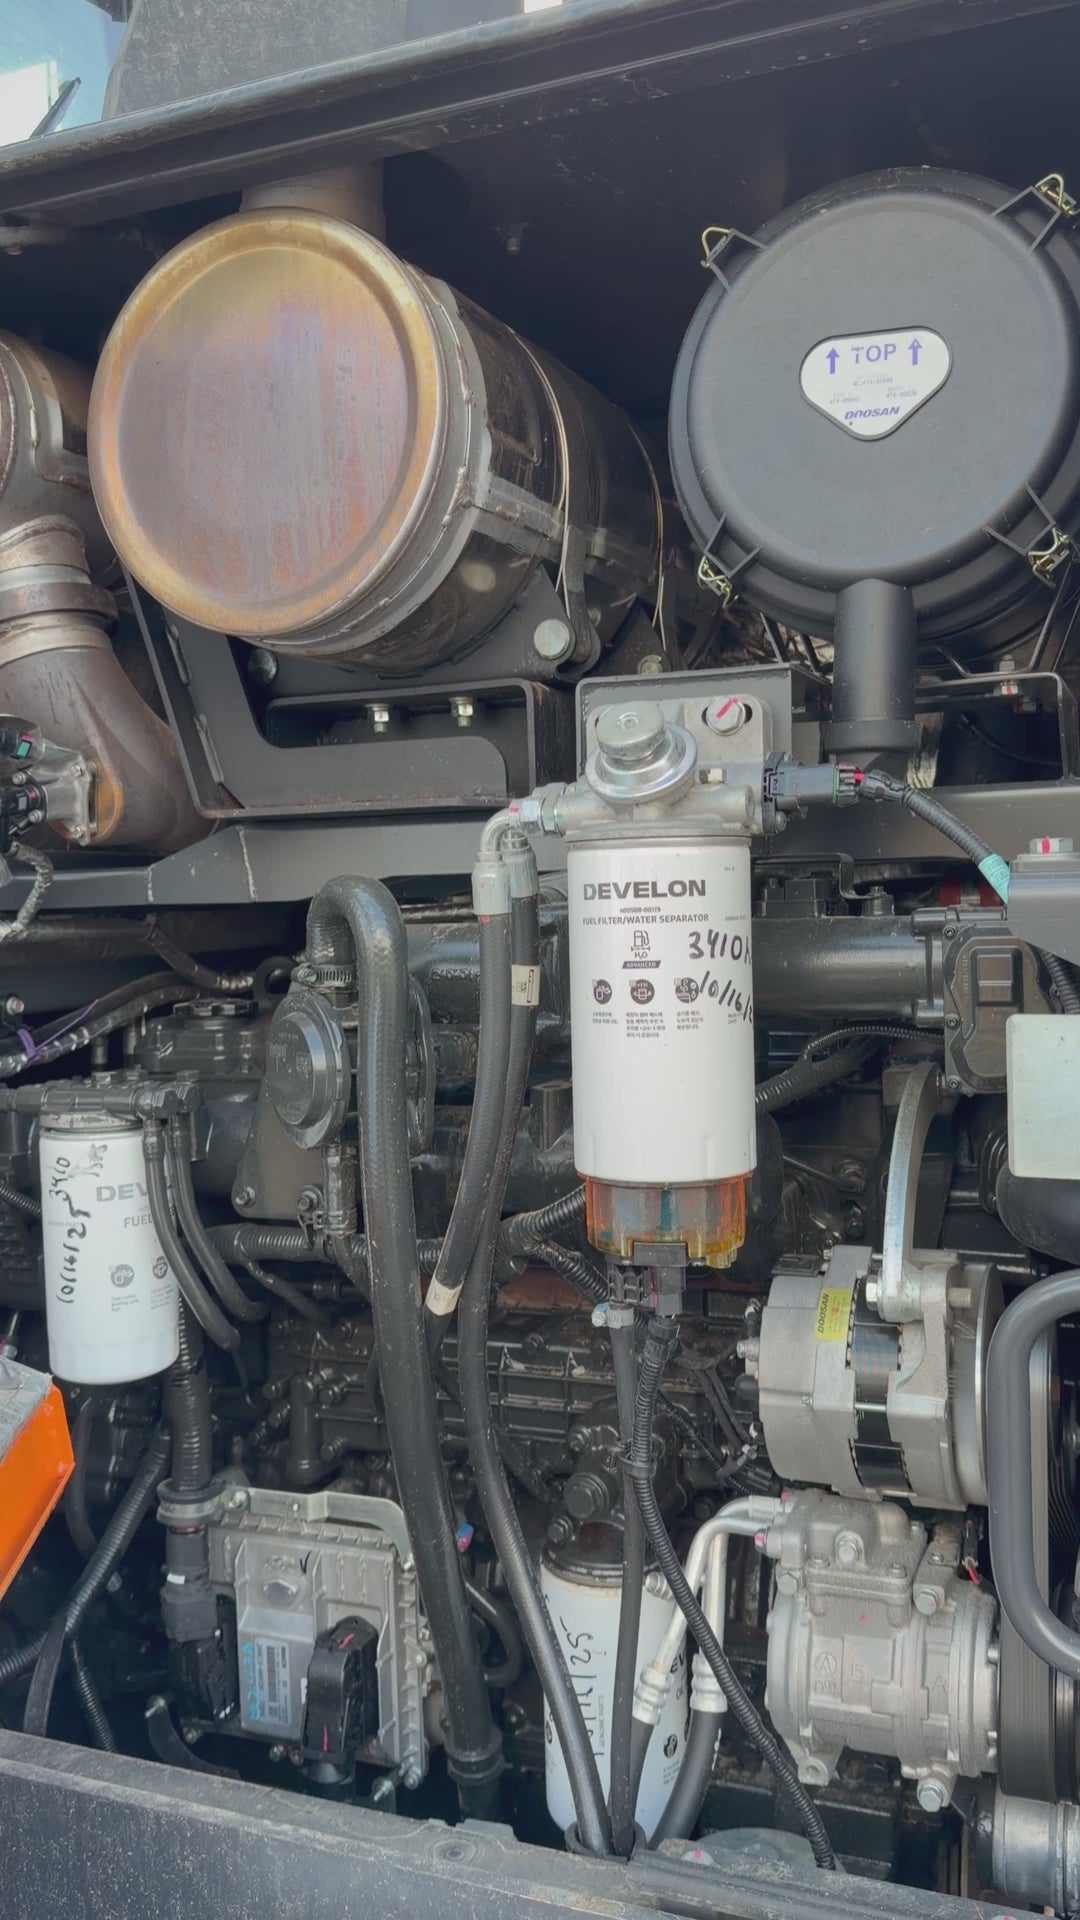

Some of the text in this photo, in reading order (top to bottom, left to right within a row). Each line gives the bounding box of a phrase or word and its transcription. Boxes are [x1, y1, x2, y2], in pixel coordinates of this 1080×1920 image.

[851, 343, 897, 364] TOP
[844, 406, 900, 420] DOOSAN
[583, 879, 706, 901] DEVELON
[582, 914, 709, 926] FUEL FILTER/WATER SEPARATOR
[625, 961, 658, 969] ADVANCED
[818, 1293, 829, 1334] DOOSAN
